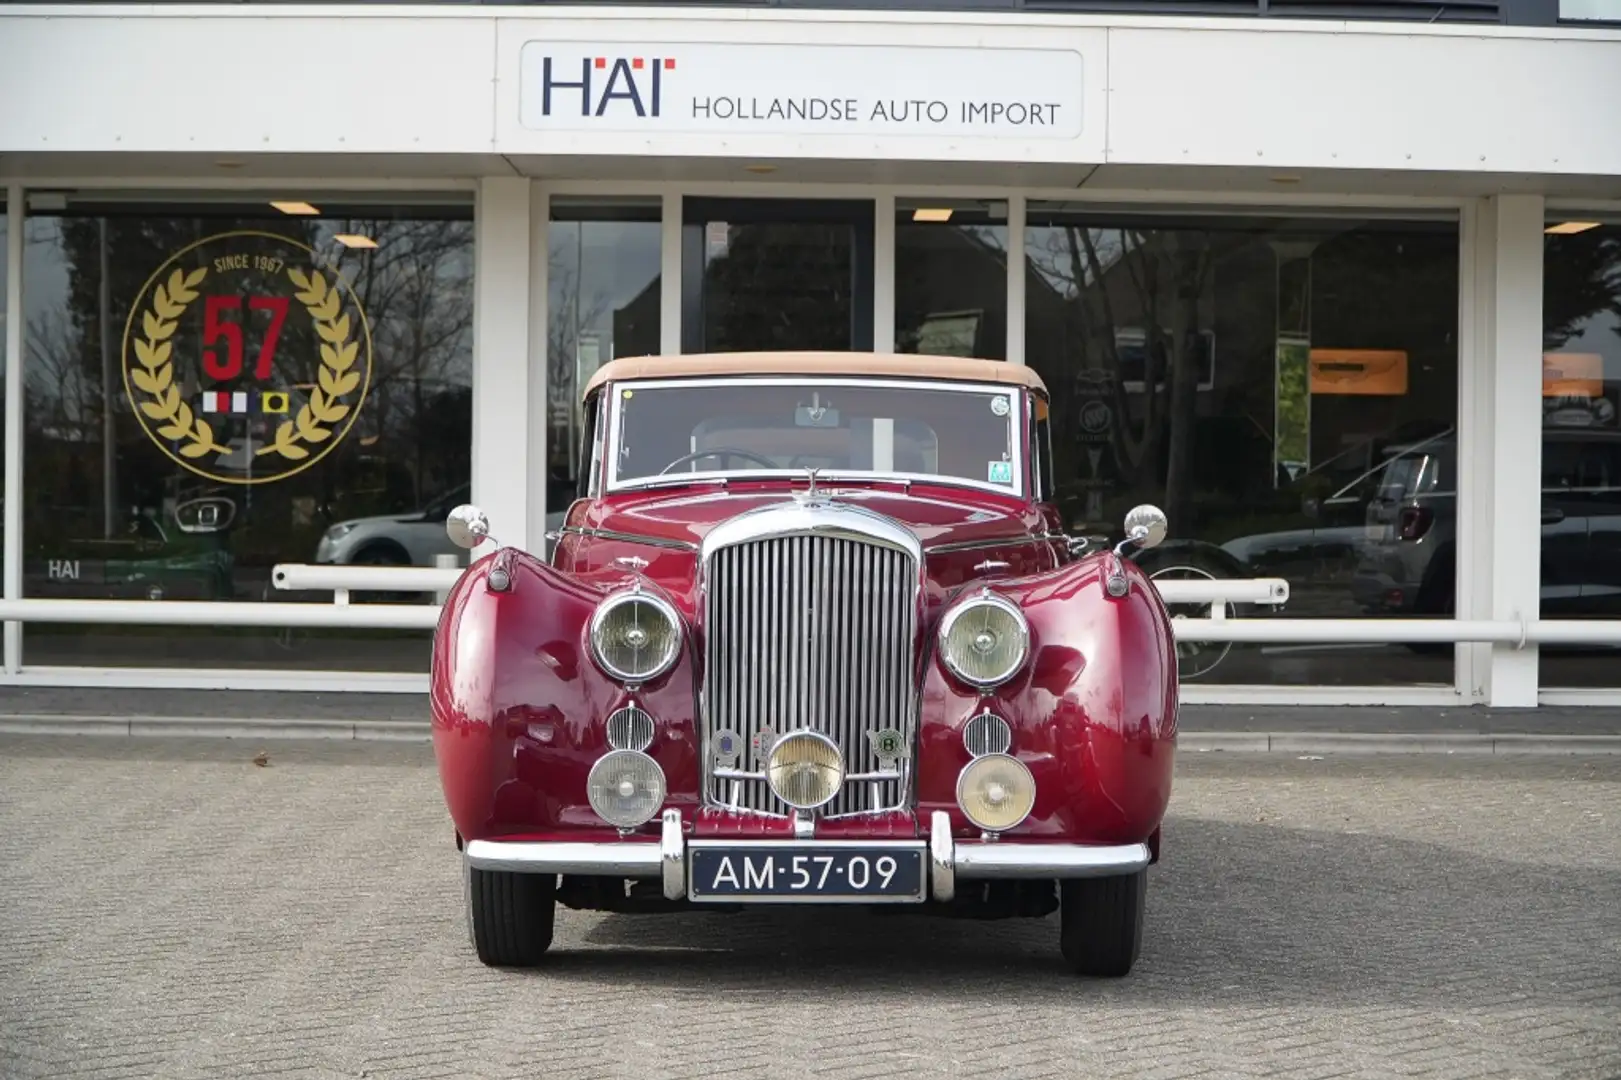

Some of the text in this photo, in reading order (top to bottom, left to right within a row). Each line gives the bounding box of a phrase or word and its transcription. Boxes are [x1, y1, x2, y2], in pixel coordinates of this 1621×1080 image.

[542, 57, 675, 117] HAI
[692, 97, 1061, 125] HOLLANDSE AUTO IMPORT
[214, 254, 284, 274] SINCE 1967
[203, 296, 290, 381] 57
[48, 560, 80, 579] HAI
